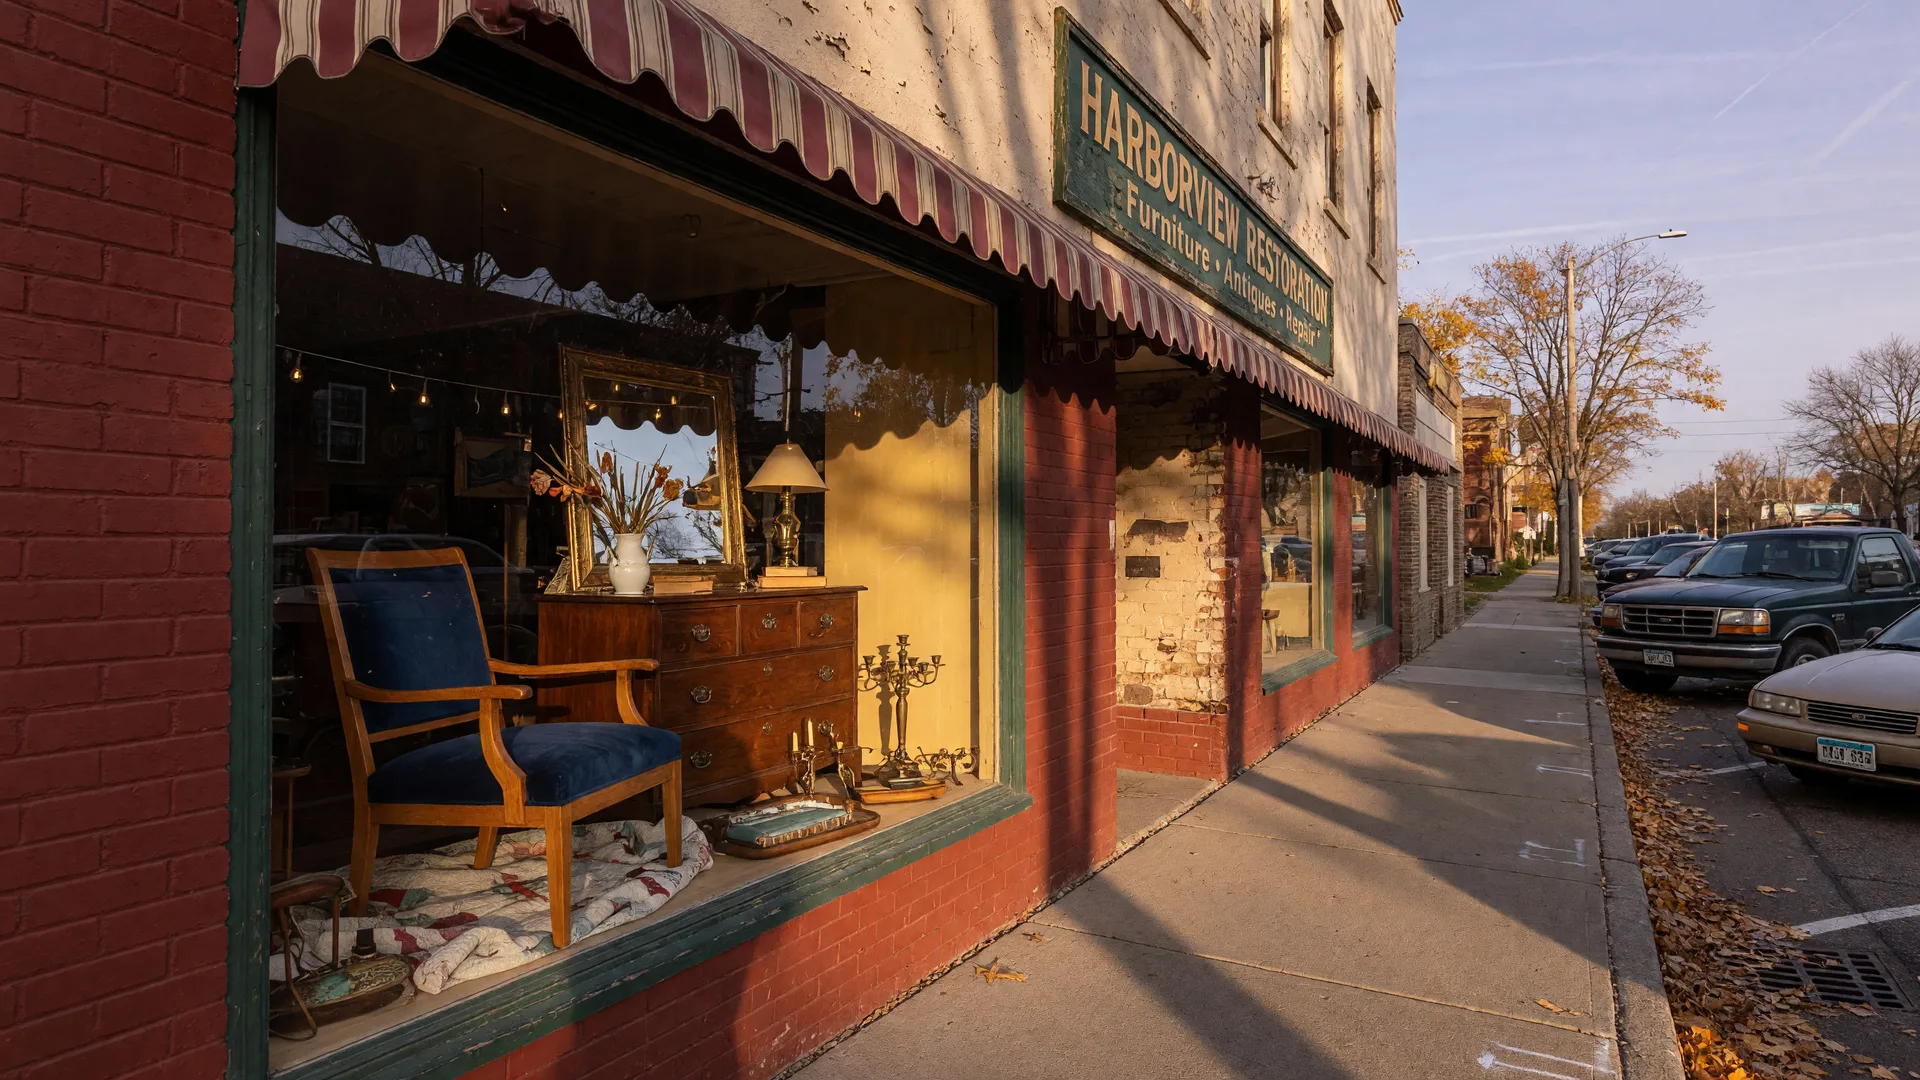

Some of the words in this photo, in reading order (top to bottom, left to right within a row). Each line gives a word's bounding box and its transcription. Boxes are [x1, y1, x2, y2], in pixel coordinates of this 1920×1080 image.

[1081, 59, 1240, 254] HARBORVIEW
[1246, 216, 1328, 327] RESTORATION
[1127, 179, 1211, 272] Furniture
[1224, 258, 1276, 318] Antiques
[1286, 304, 1316, 346] Repair
